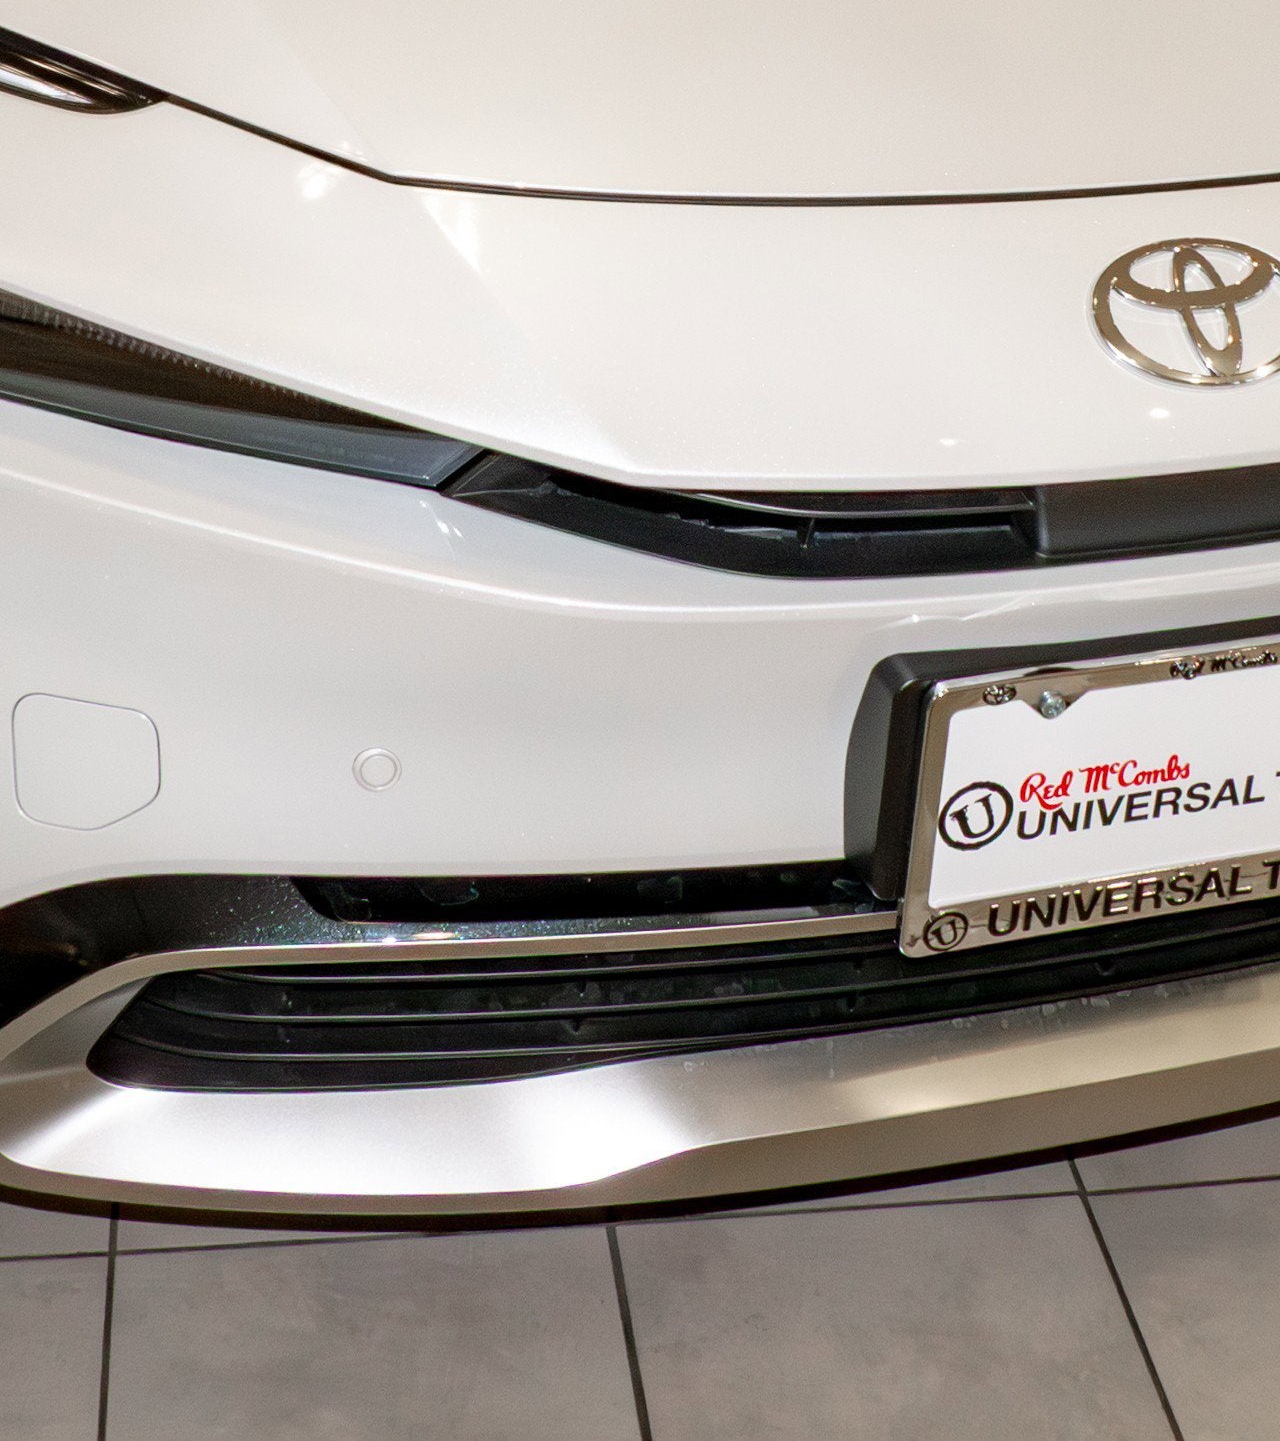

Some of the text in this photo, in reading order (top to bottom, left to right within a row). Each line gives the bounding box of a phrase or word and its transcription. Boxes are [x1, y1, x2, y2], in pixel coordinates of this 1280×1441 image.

[1016, 777, 1265, 841] UNIVERSAL
[1019, 754, 1191, 811] Red McCombs
[986, 865, 1253, 938] UNIVERSAL
